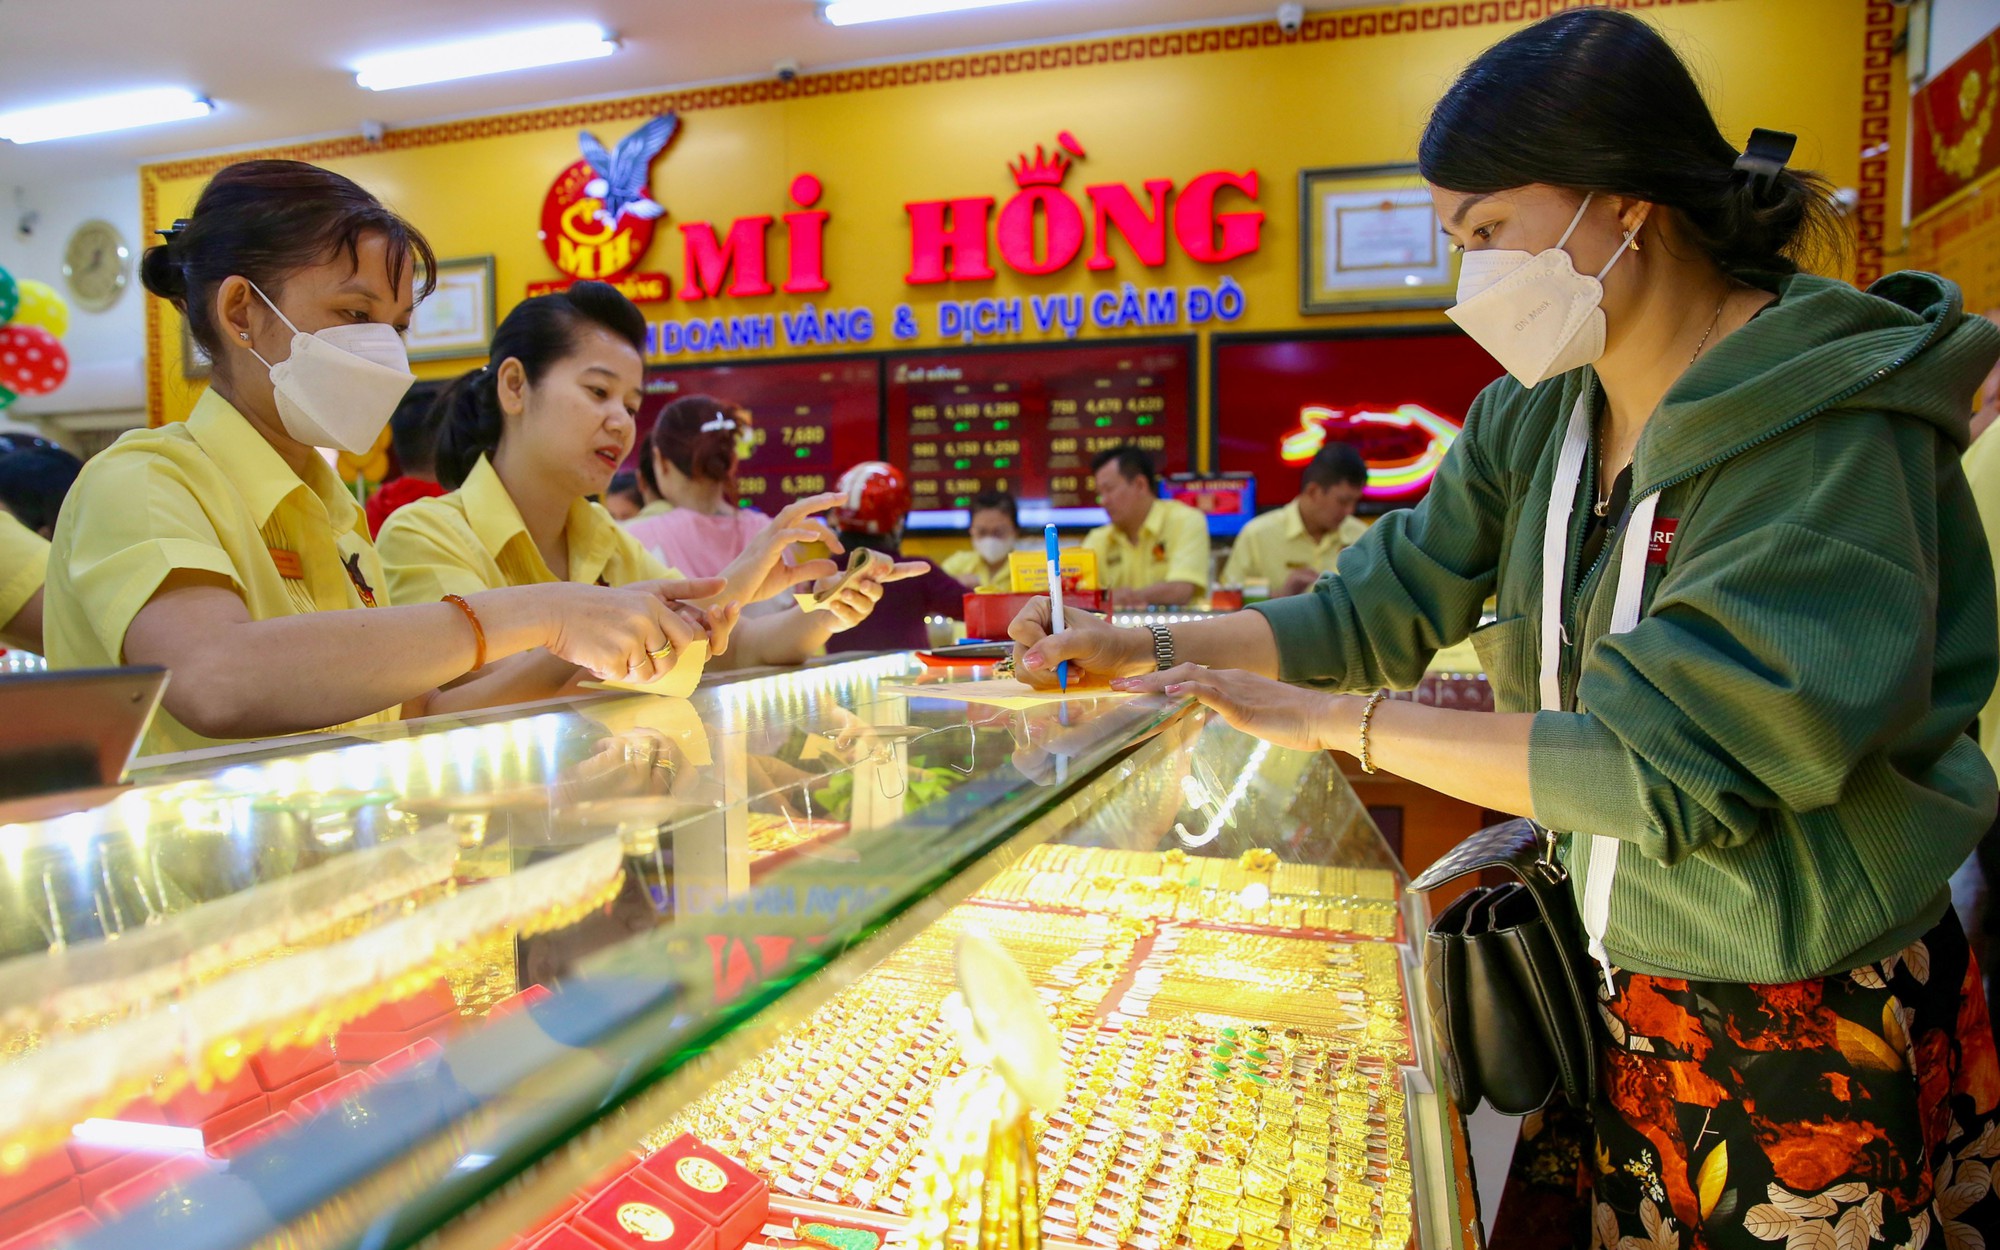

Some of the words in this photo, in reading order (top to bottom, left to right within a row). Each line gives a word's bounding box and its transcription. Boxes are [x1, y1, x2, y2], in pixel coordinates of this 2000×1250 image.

[662, 314, 775, 355] DOANH
[782, 302, 874, 346] VÀNG
[892, 304, 919, 340] &
[939, 297, 1022, 344] DỊCH
[1029, 292, 1084, 339] VỤ
